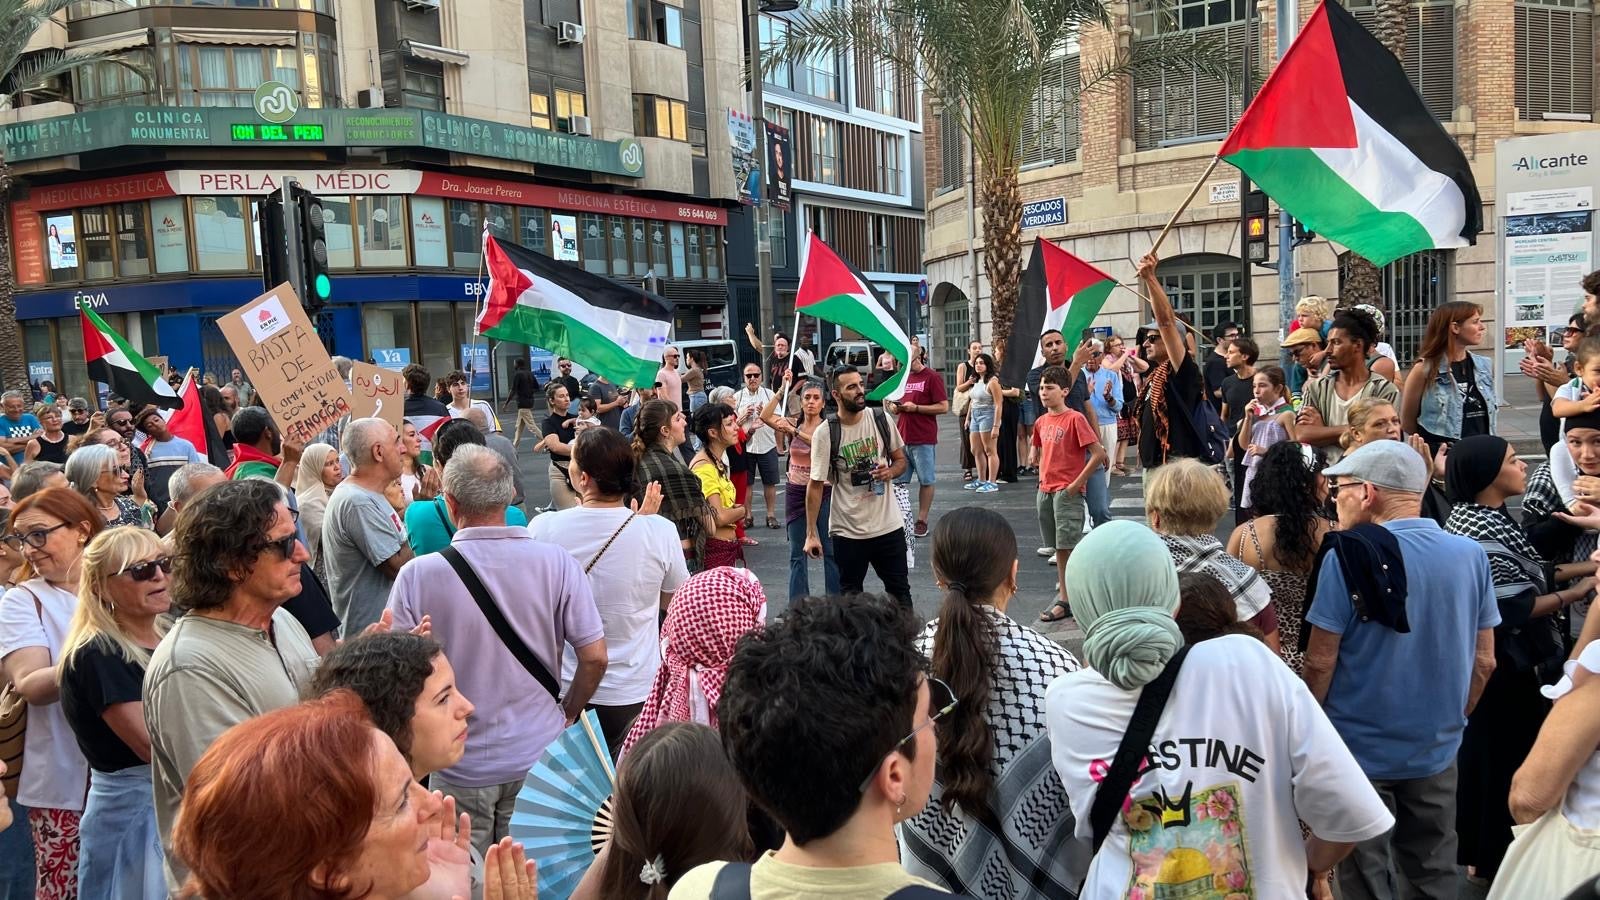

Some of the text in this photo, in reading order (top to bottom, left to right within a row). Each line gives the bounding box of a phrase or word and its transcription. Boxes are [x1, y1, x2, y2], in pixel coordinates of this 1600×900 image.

[135, 112, 203, 124] CLINICA
[346, 116, 414, 127] RECONOCIMIENTOS
[131, 127, 209, 140] MONUMENTAL
[261, 125, 288, 140] DEL
[424, 116, 492, 139] CLINICA
[1511, 153, 1588, 171] Alicante
[200, 174, 277, 190] PERLA
[41, 186, 101, 205] MEDICINA
[442, 180, 462, 192] Dra.
[464, 181, 493, 196] Joanet
[495, 186, 522, 198] Perera
[558, 191, 610, 209] MEDICINA
[678, 206, 692, 217] 865
[693, 208, 704, 218] 644
[705, 209, 718, 220] 069
[1023, 200, 1061, 215] PESCADOS
[1024, 211, 1062, 226] VERDURAS
[74, 292, 109, 309] BBVA
[248, 325, 311, 372] BASTA
[382, 350, 401, 362] Ya
[30, 365, 53, 375] Entra
[281, 354, 313, 382] DE
[283, 402, 306, 421] CON
